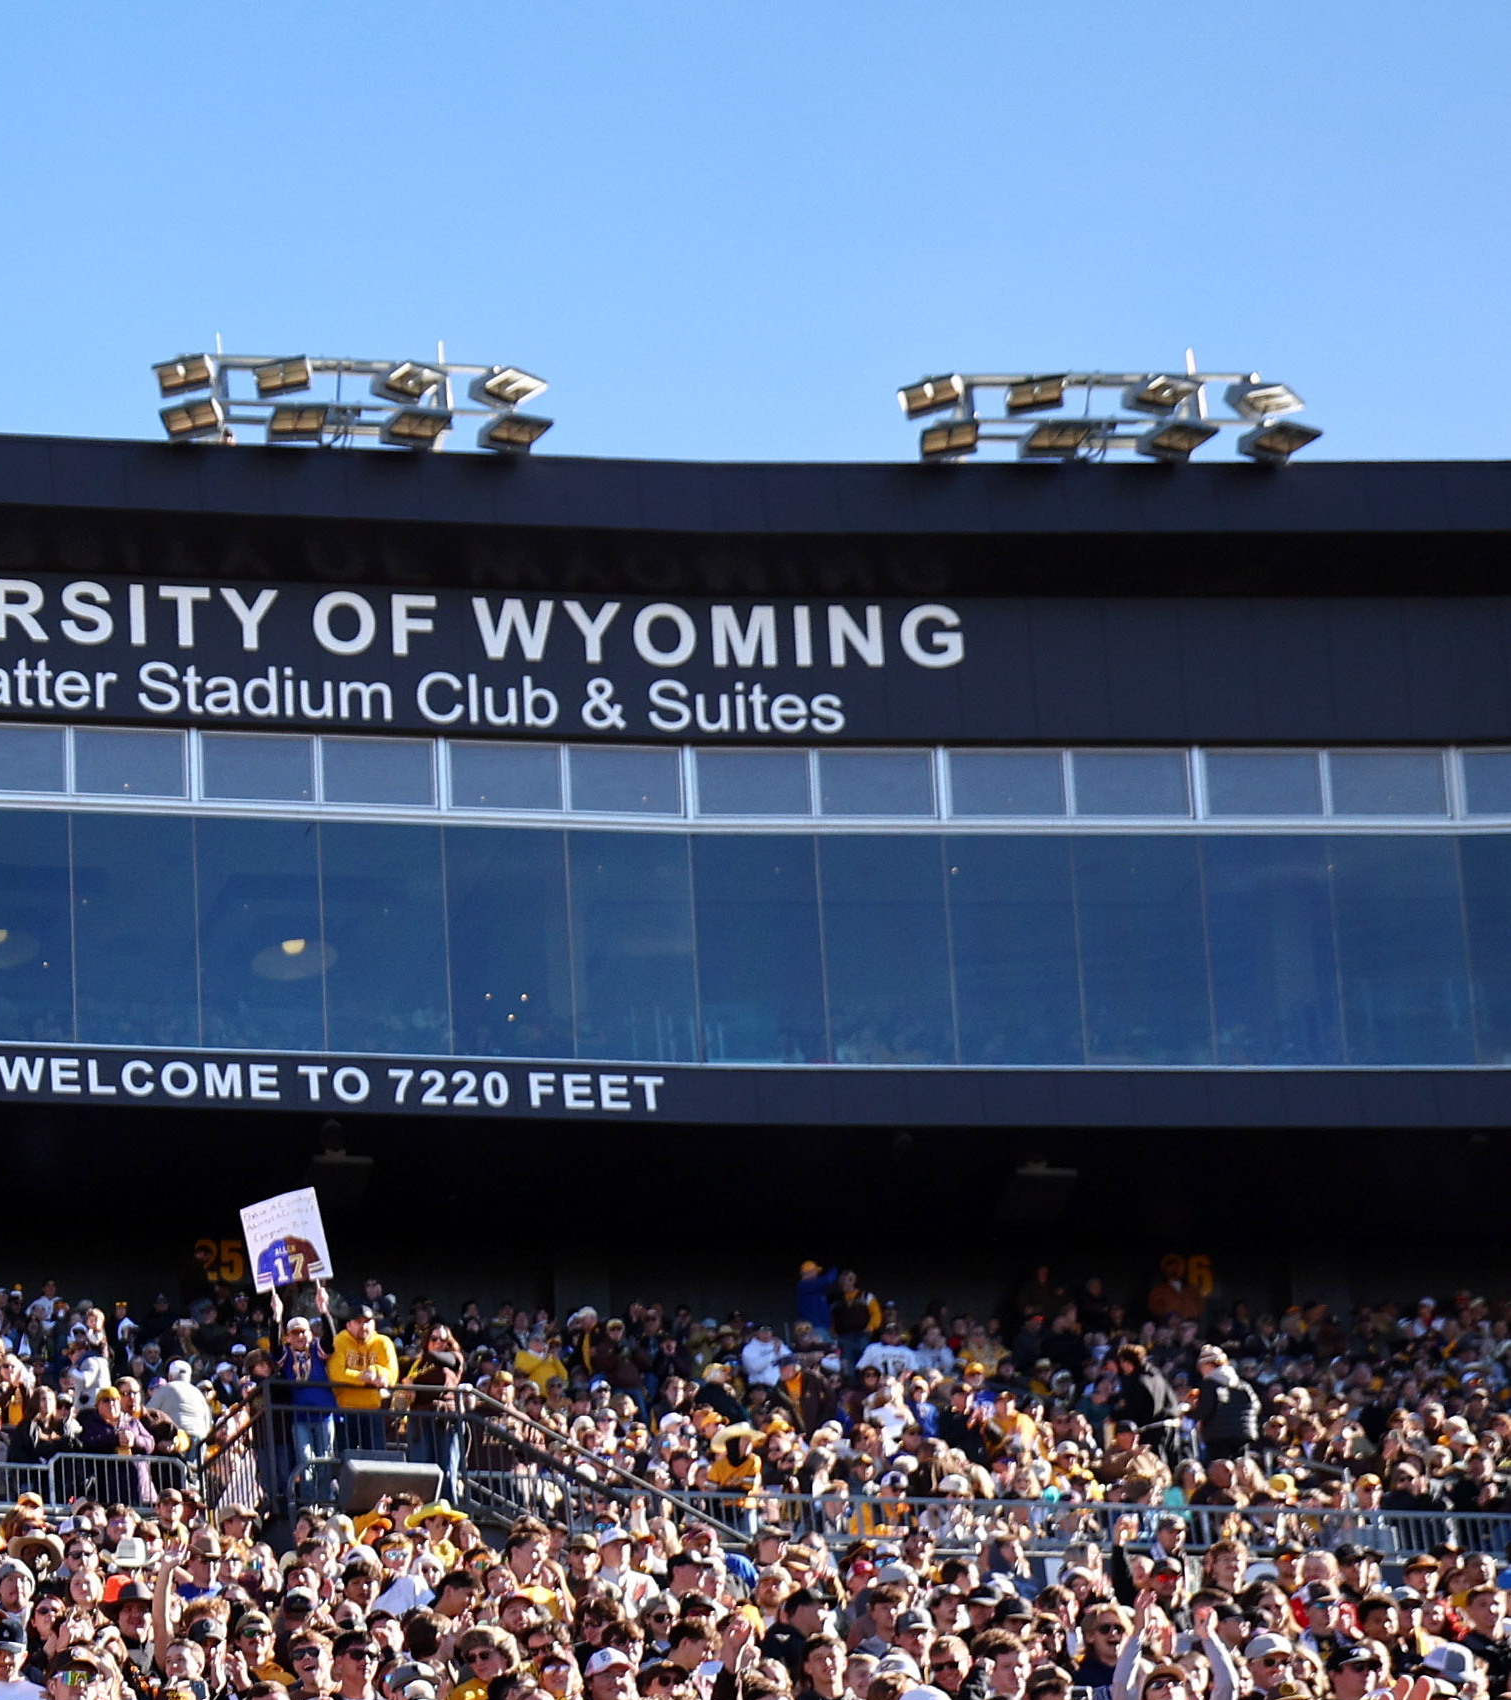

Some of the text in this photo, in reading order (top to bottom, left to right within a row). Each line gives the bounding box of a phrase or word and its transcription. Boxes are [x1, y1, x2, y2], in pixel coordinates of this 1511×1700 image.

[312, 591, 437, 657] OF
[471, 596, 966, 669] WYOMING
[137, 660, 395, 721] Stadium
[416, 671, 559, 729] Club
[581, 676, 628, 731] &
[647, 679, 847, 735] Suites
[297, 1064, 372, 1103] TO
[387, 1068, 511, 1108] 7220
[528, 1073, 666, 1113] FEET
[194, 1239, 245, 1283] 25
[273, 1251, 305, 1283] 17
